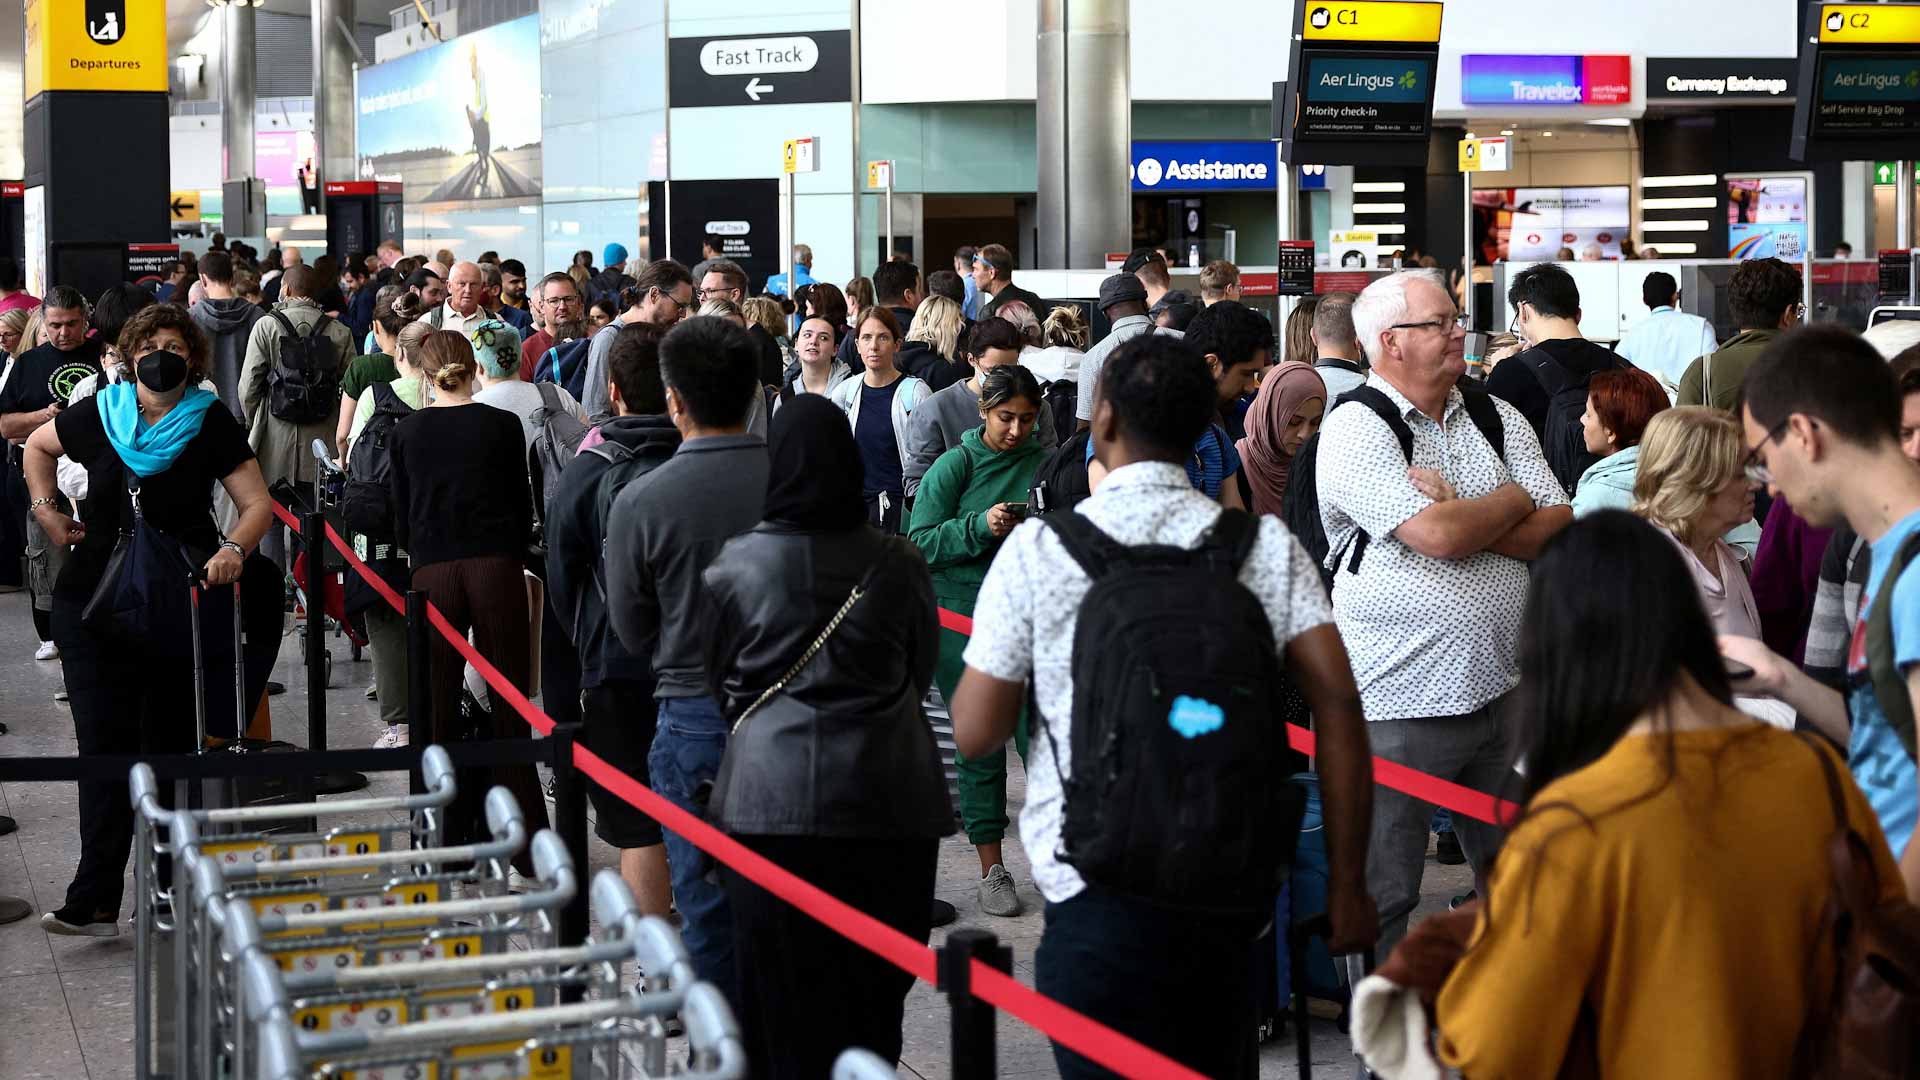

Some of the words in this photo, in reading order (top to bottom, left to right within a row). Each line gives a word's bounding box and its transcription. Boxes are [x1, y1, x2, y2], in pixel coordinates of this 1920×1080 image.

[1337, 9, 1358, 25] C1
[1850, 13, 1870, 28] C2
[716, 50, 750, 65] Fast
[756, 46, 802, 63] Track
[70, 58, 141, 71] Departures
[1320, 73, 1347, 86] Aer
[1348, 73, 1394, 91] Lingus
[1666, 75, 1726, 95] Currency
[1727, 75, 1787, 95] Exchange
[1834, 72, 1857, 86] Aer
[1858, 72, 1900, 90] Lingus
[1510, 80, 1582, 100] Travelex
[1306, 106, 1339, 118] Priority
[1340, 107, 1378, 117] check-in
[1821, 104, 1837, 114] Self
[1838, 104, 1866, 114] Service
[1867, 105, 1883, 116] Bag
[1884, 105, 1905, 116] Drop
[1165, 159, 1268, 180] Assistance
[128, 256, 161, 265] assengers
[128, 264, 144, 272] rom
[144, 264, 157, 272] this
